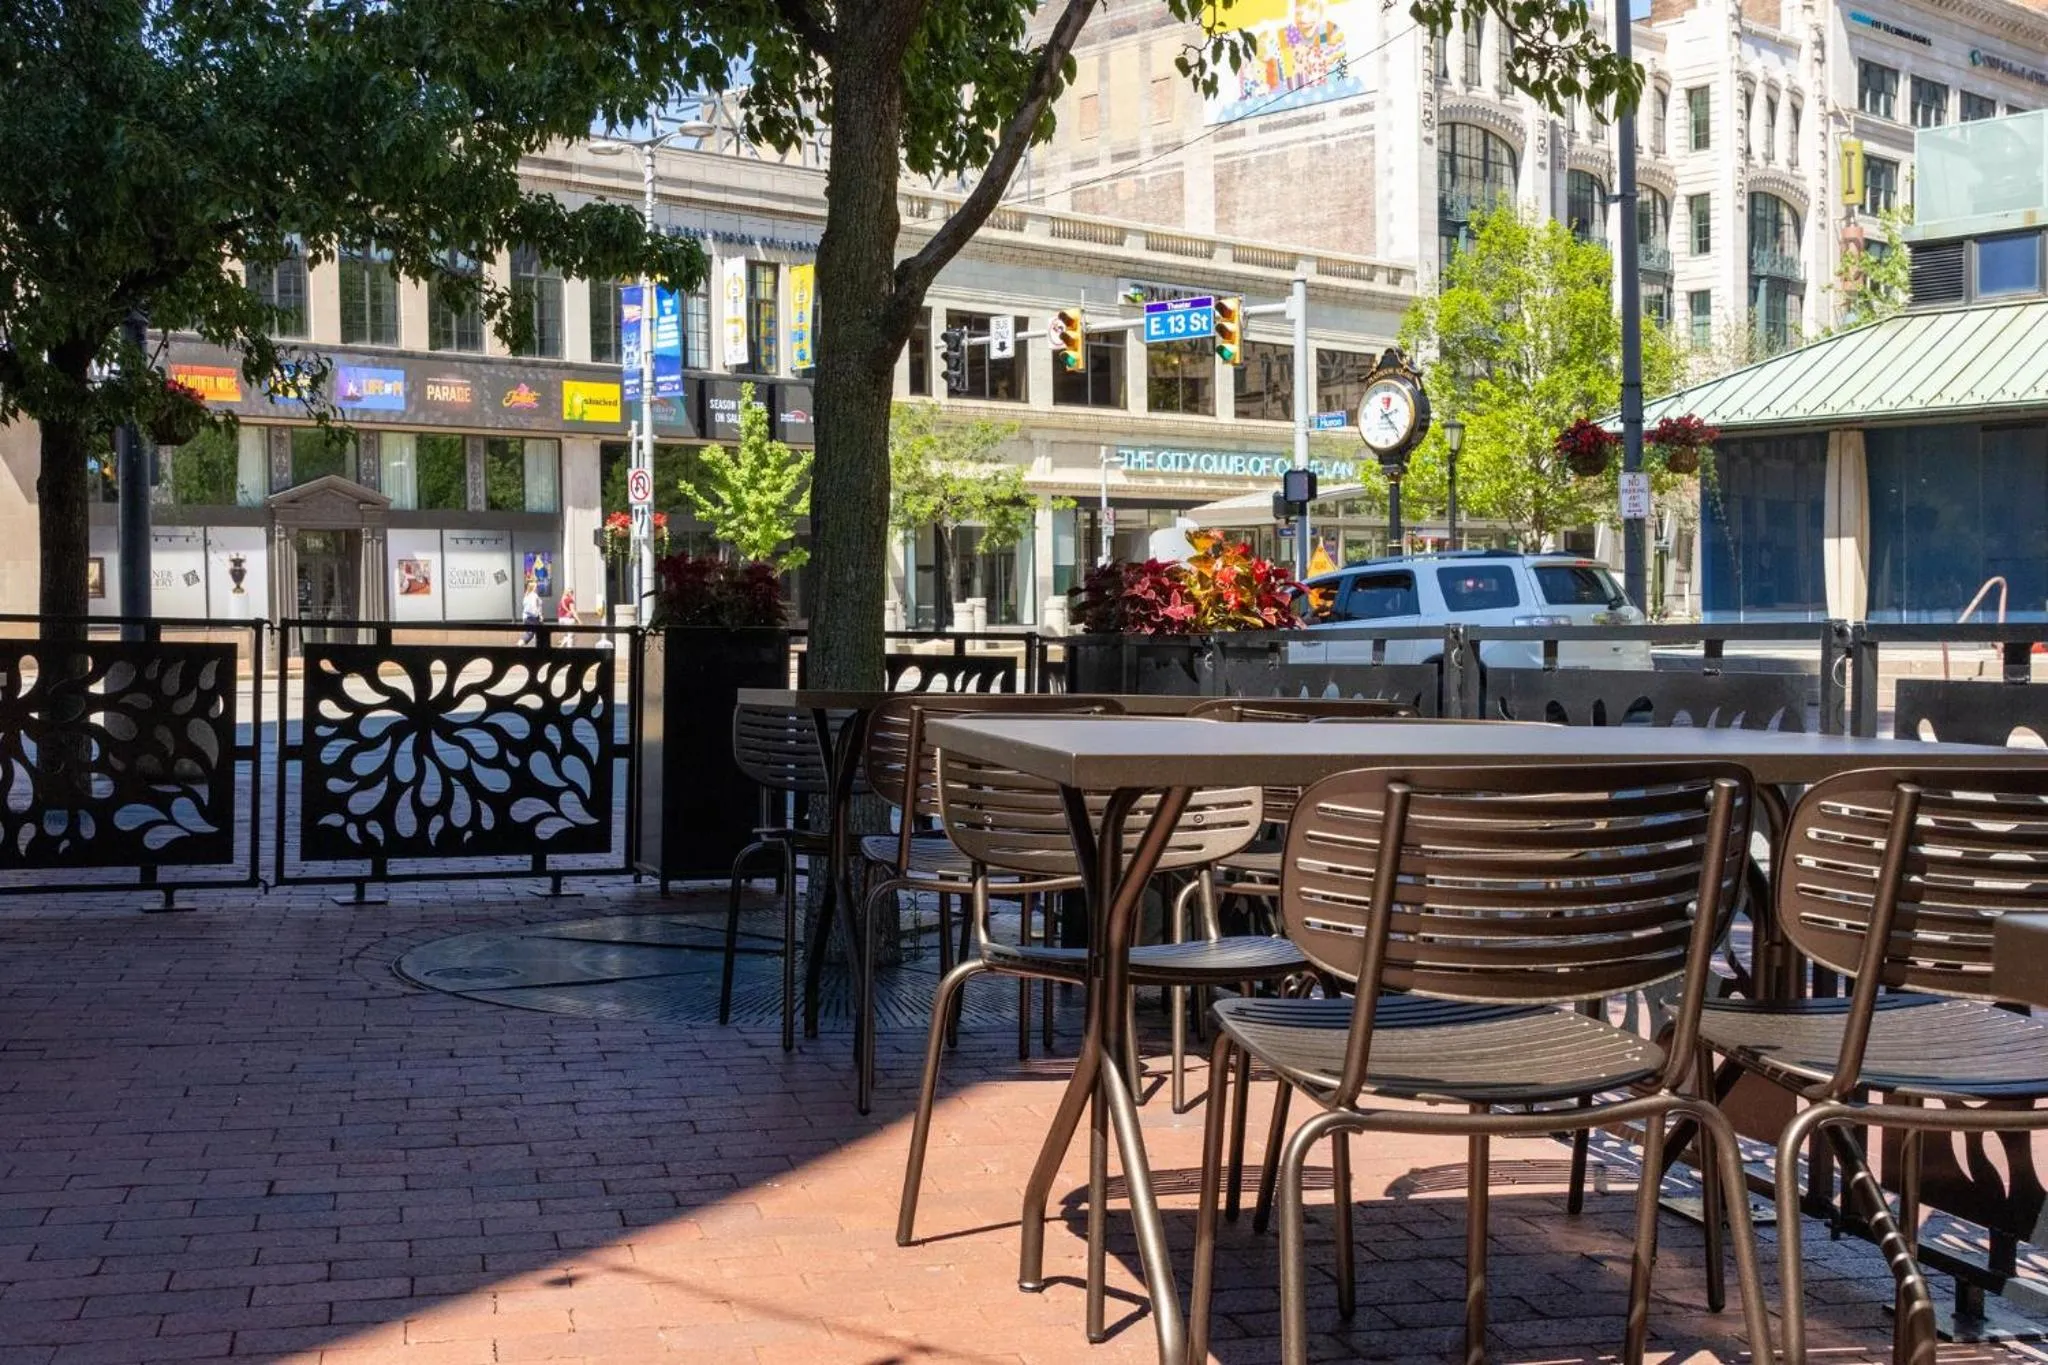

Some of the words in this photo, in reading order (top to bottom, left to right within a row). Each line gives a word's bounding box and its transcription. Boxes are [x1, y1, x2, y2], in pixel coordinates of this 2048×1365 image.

[1150, 317, 1165, 336] E.
[1168, 314, 1186, 334] 13
[1189, 312, 1208, 332] St
[427, 384, 472, 403] PARADE
[583, 397, 618, 407] shucked
[709, 399, 737, 411] SEASON
[715, 412, 725, 423] ON
[1119, 449, 1154, 470] THE
[1157, 451, 1197, 473] CITY
[1200, 453, 1246, 476] CLUB
[1249, 456, 1273, 477] OF
[1628, 479, 1640, 487] NO
